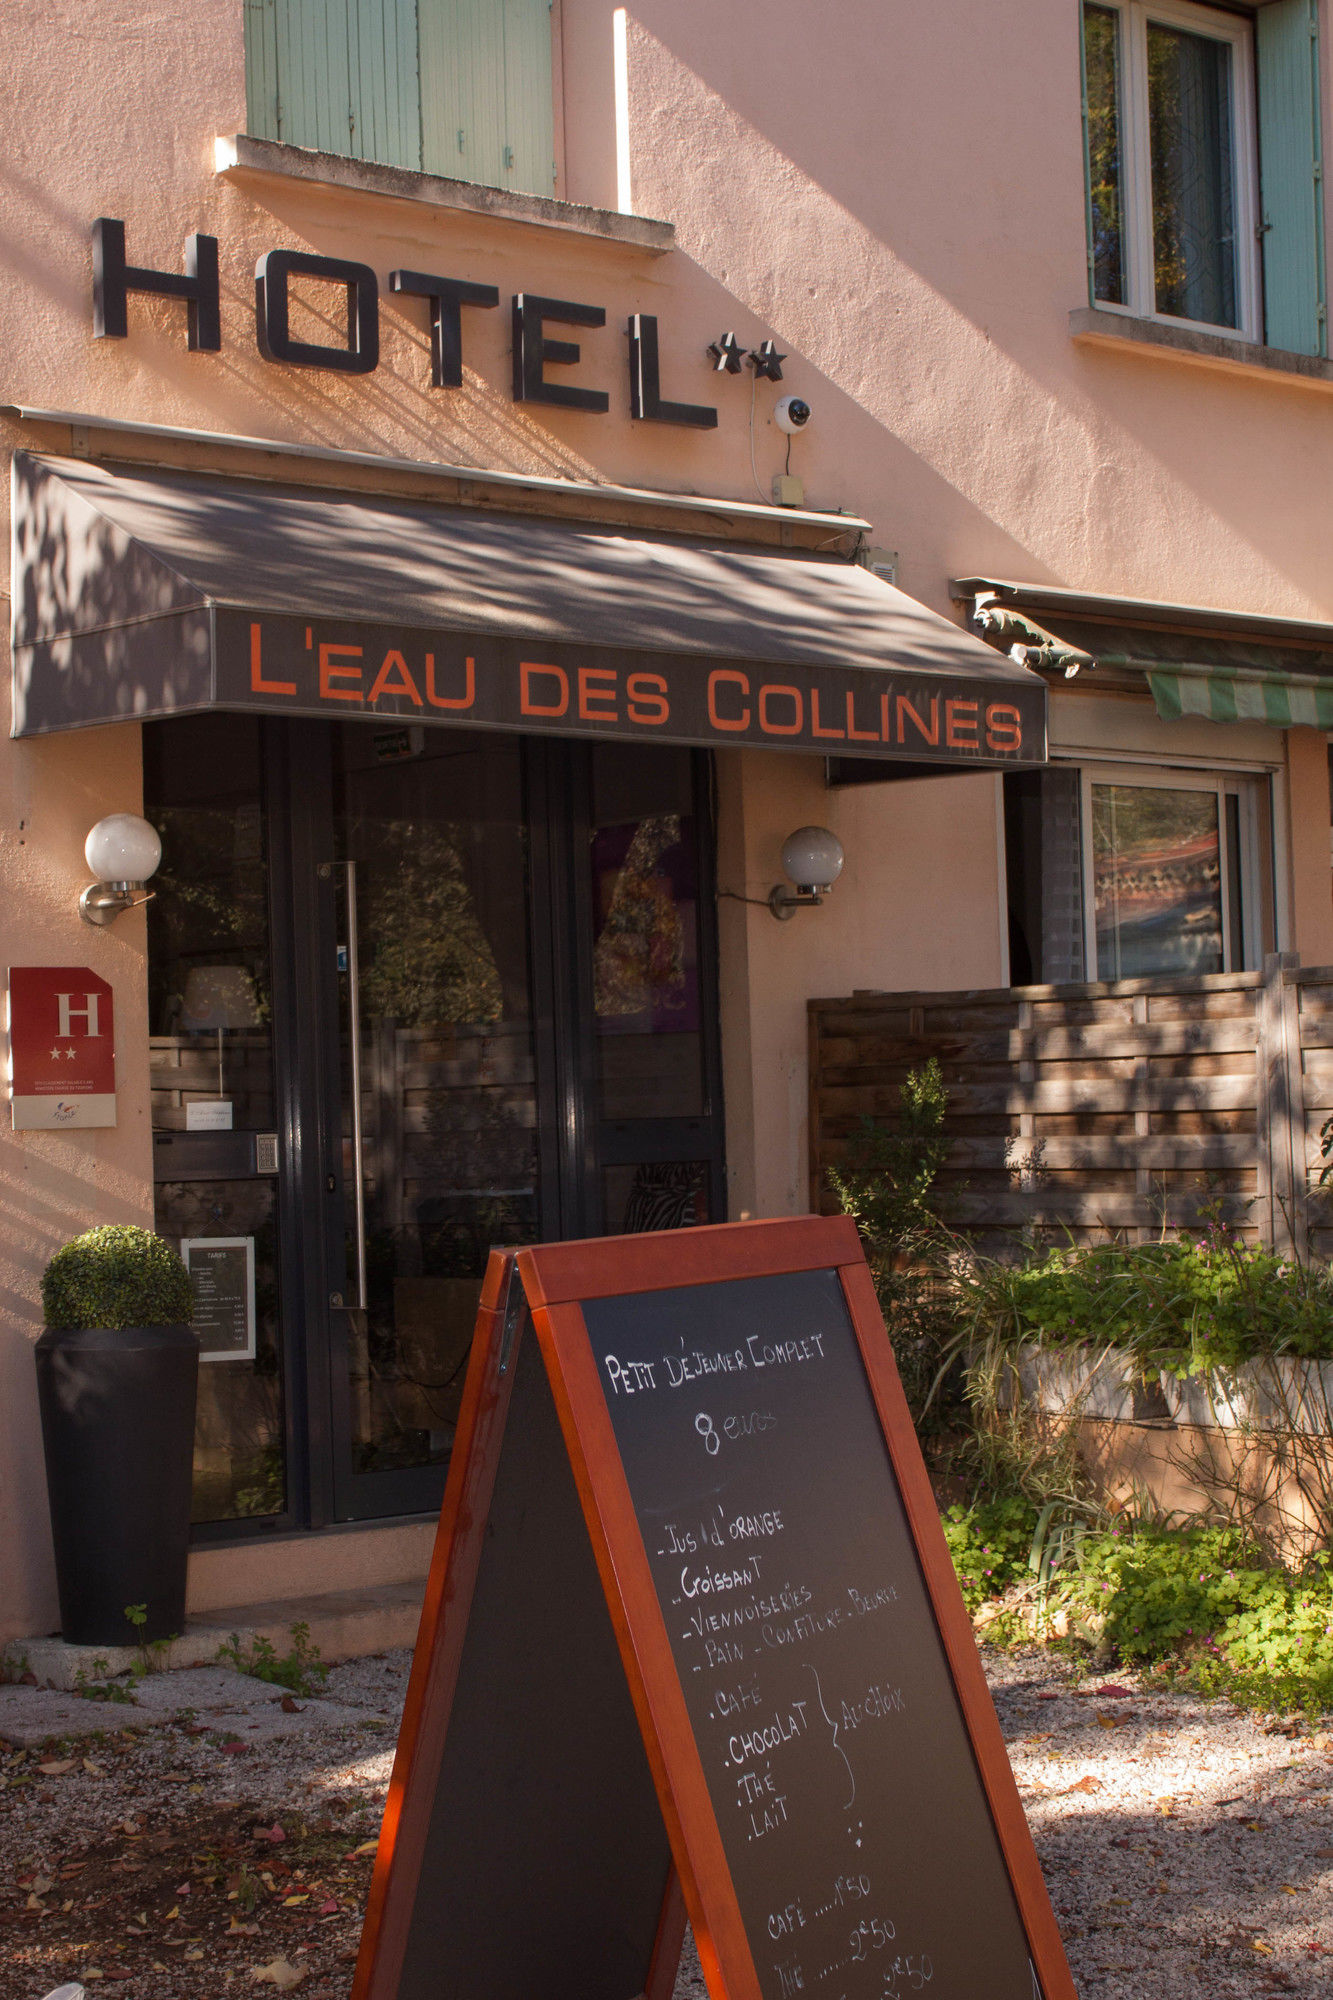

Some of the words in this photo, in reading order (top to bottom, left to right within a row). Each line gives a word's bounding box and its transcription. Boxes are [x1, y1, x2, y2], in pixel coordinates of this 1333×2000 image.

[93, 217, 717, 428] HOTEL
[251, 623, 475, 710] L'EAU
[520, 661, 669, 725] DES
[707, 669, 1022, 752] COLLINES
[53, 993, 104, 1038] H
[747, 1333, 824, 1367] COMPLET
[694, 1412, 720, 1456] 8
[729, 1701, 807, 1764] CHOCOLAT
